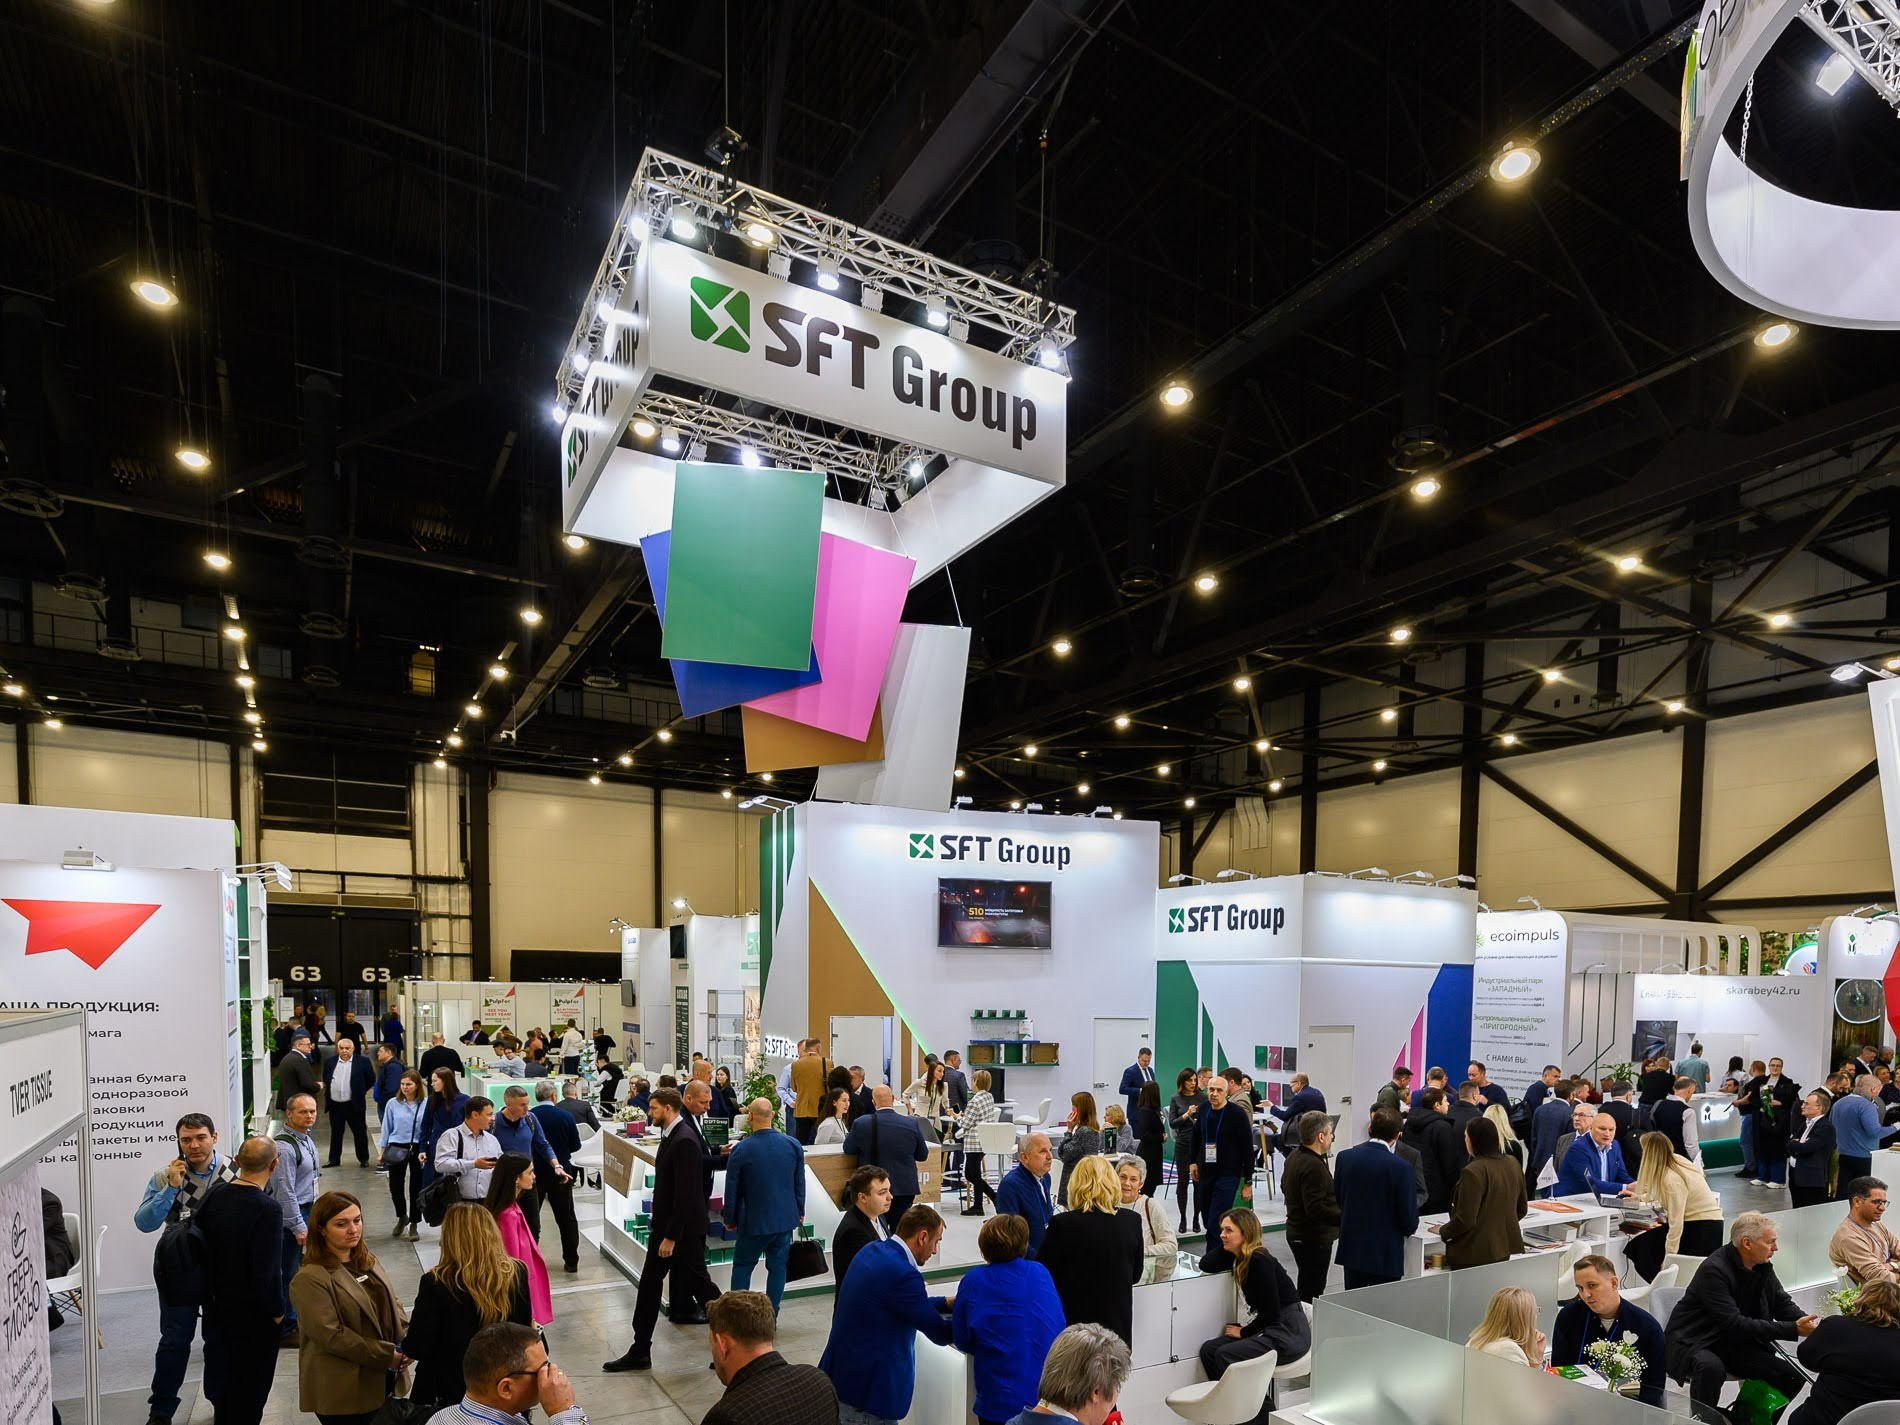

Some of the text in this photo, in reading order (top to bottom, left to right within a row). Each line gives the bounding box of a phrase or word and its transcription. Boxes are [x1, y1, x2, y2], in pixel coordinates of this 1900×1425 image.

[763, 302, 1037, 450] SFT Group
[940, 835, 1071, 870] SFT Group
[968, 907, 984, 916] 510
[1188, 903, 1285, 935] SFT Group
[1490, 928, 1560, 943] ecoimpuls
[290, 966, 322, 982] 63
[362, 967, 391, 983] 63
[1726, 986, 1801, 996] skarabey42.ru
[46, 1001, 160, 1013] ПРОДУКЦИЯ:
[88, 1029, 122, 1038] мага
[1492, 1055, 1514, 1063] НАМИ
[90, 1073, 187, 1085] анная бумага
[10, 1069, 53, 1118] TVER TISSUE
[92, 1087, 189, 1100] одноразовой
[92, 1105, 145, 1115] аковки
[91, 1120, 164, 1132] родукции
[145, 1133, 154, 1143] и
[158, 1132, 178, 1143] ме
